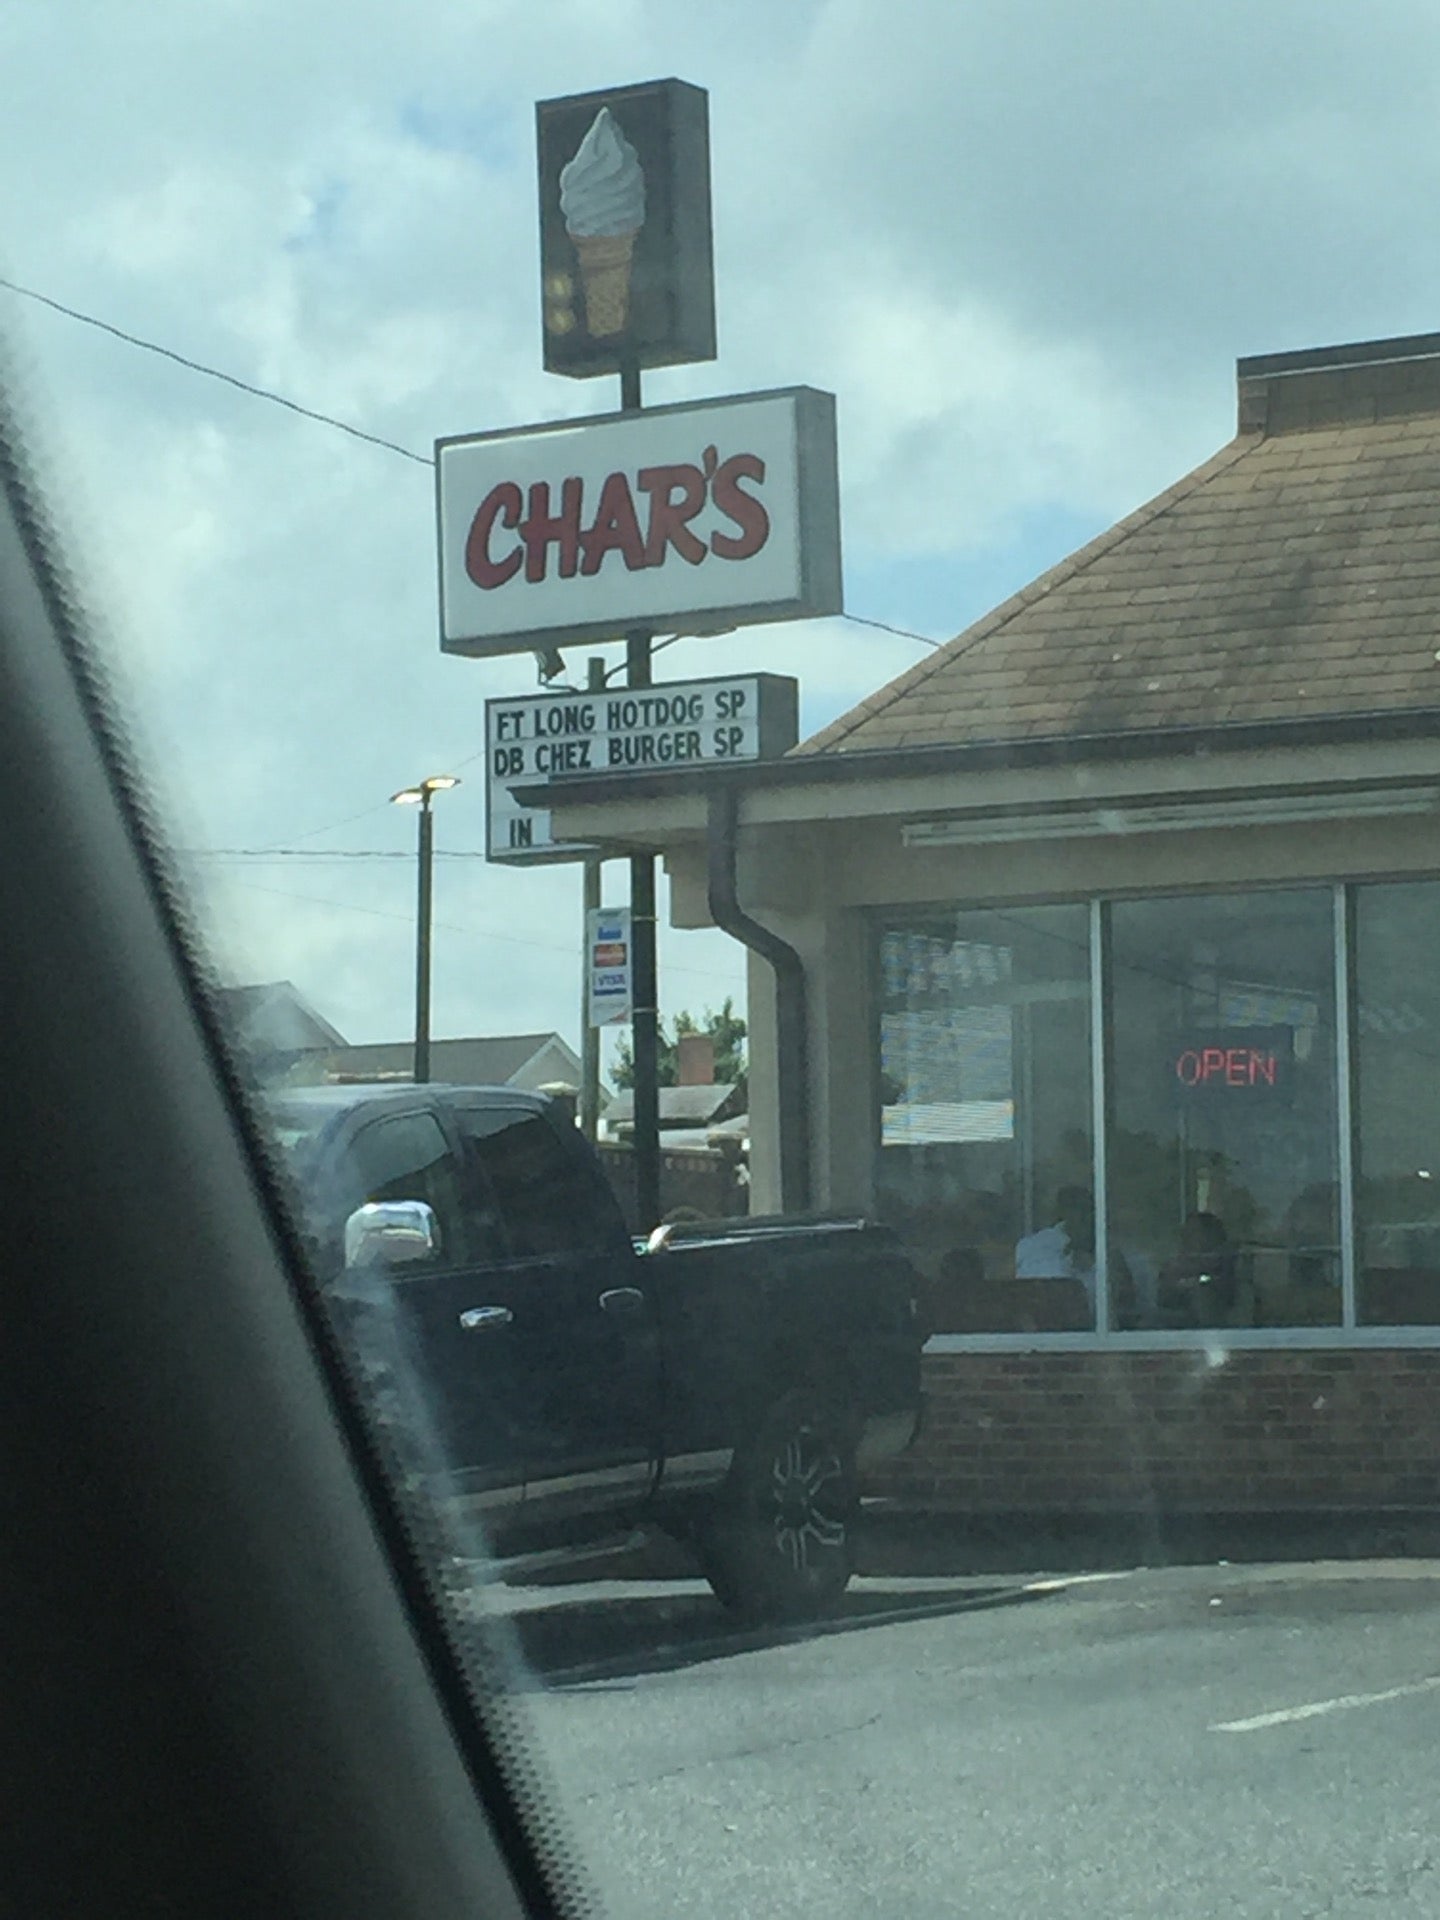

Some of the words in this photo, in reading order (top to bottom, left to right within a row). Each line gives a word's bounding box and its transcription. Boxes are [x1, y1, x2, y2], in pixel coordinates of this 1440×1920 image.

[465, 444, 769, 591] CHAR'S
[497, 710, 525, 740] FT
[534, 704, 595, 737] LONG
[607, 694, 704, 730] HOTDOG
[715, 689, 746, 719] SP
[494, 746, 524, 777] DB
[535, 740, 591, 773] CHEZ
[608, 731, 702, 765] BURGER
[510, 818, 532, 849] IN
[1176, 1049, 1276, 1086] OPEN
